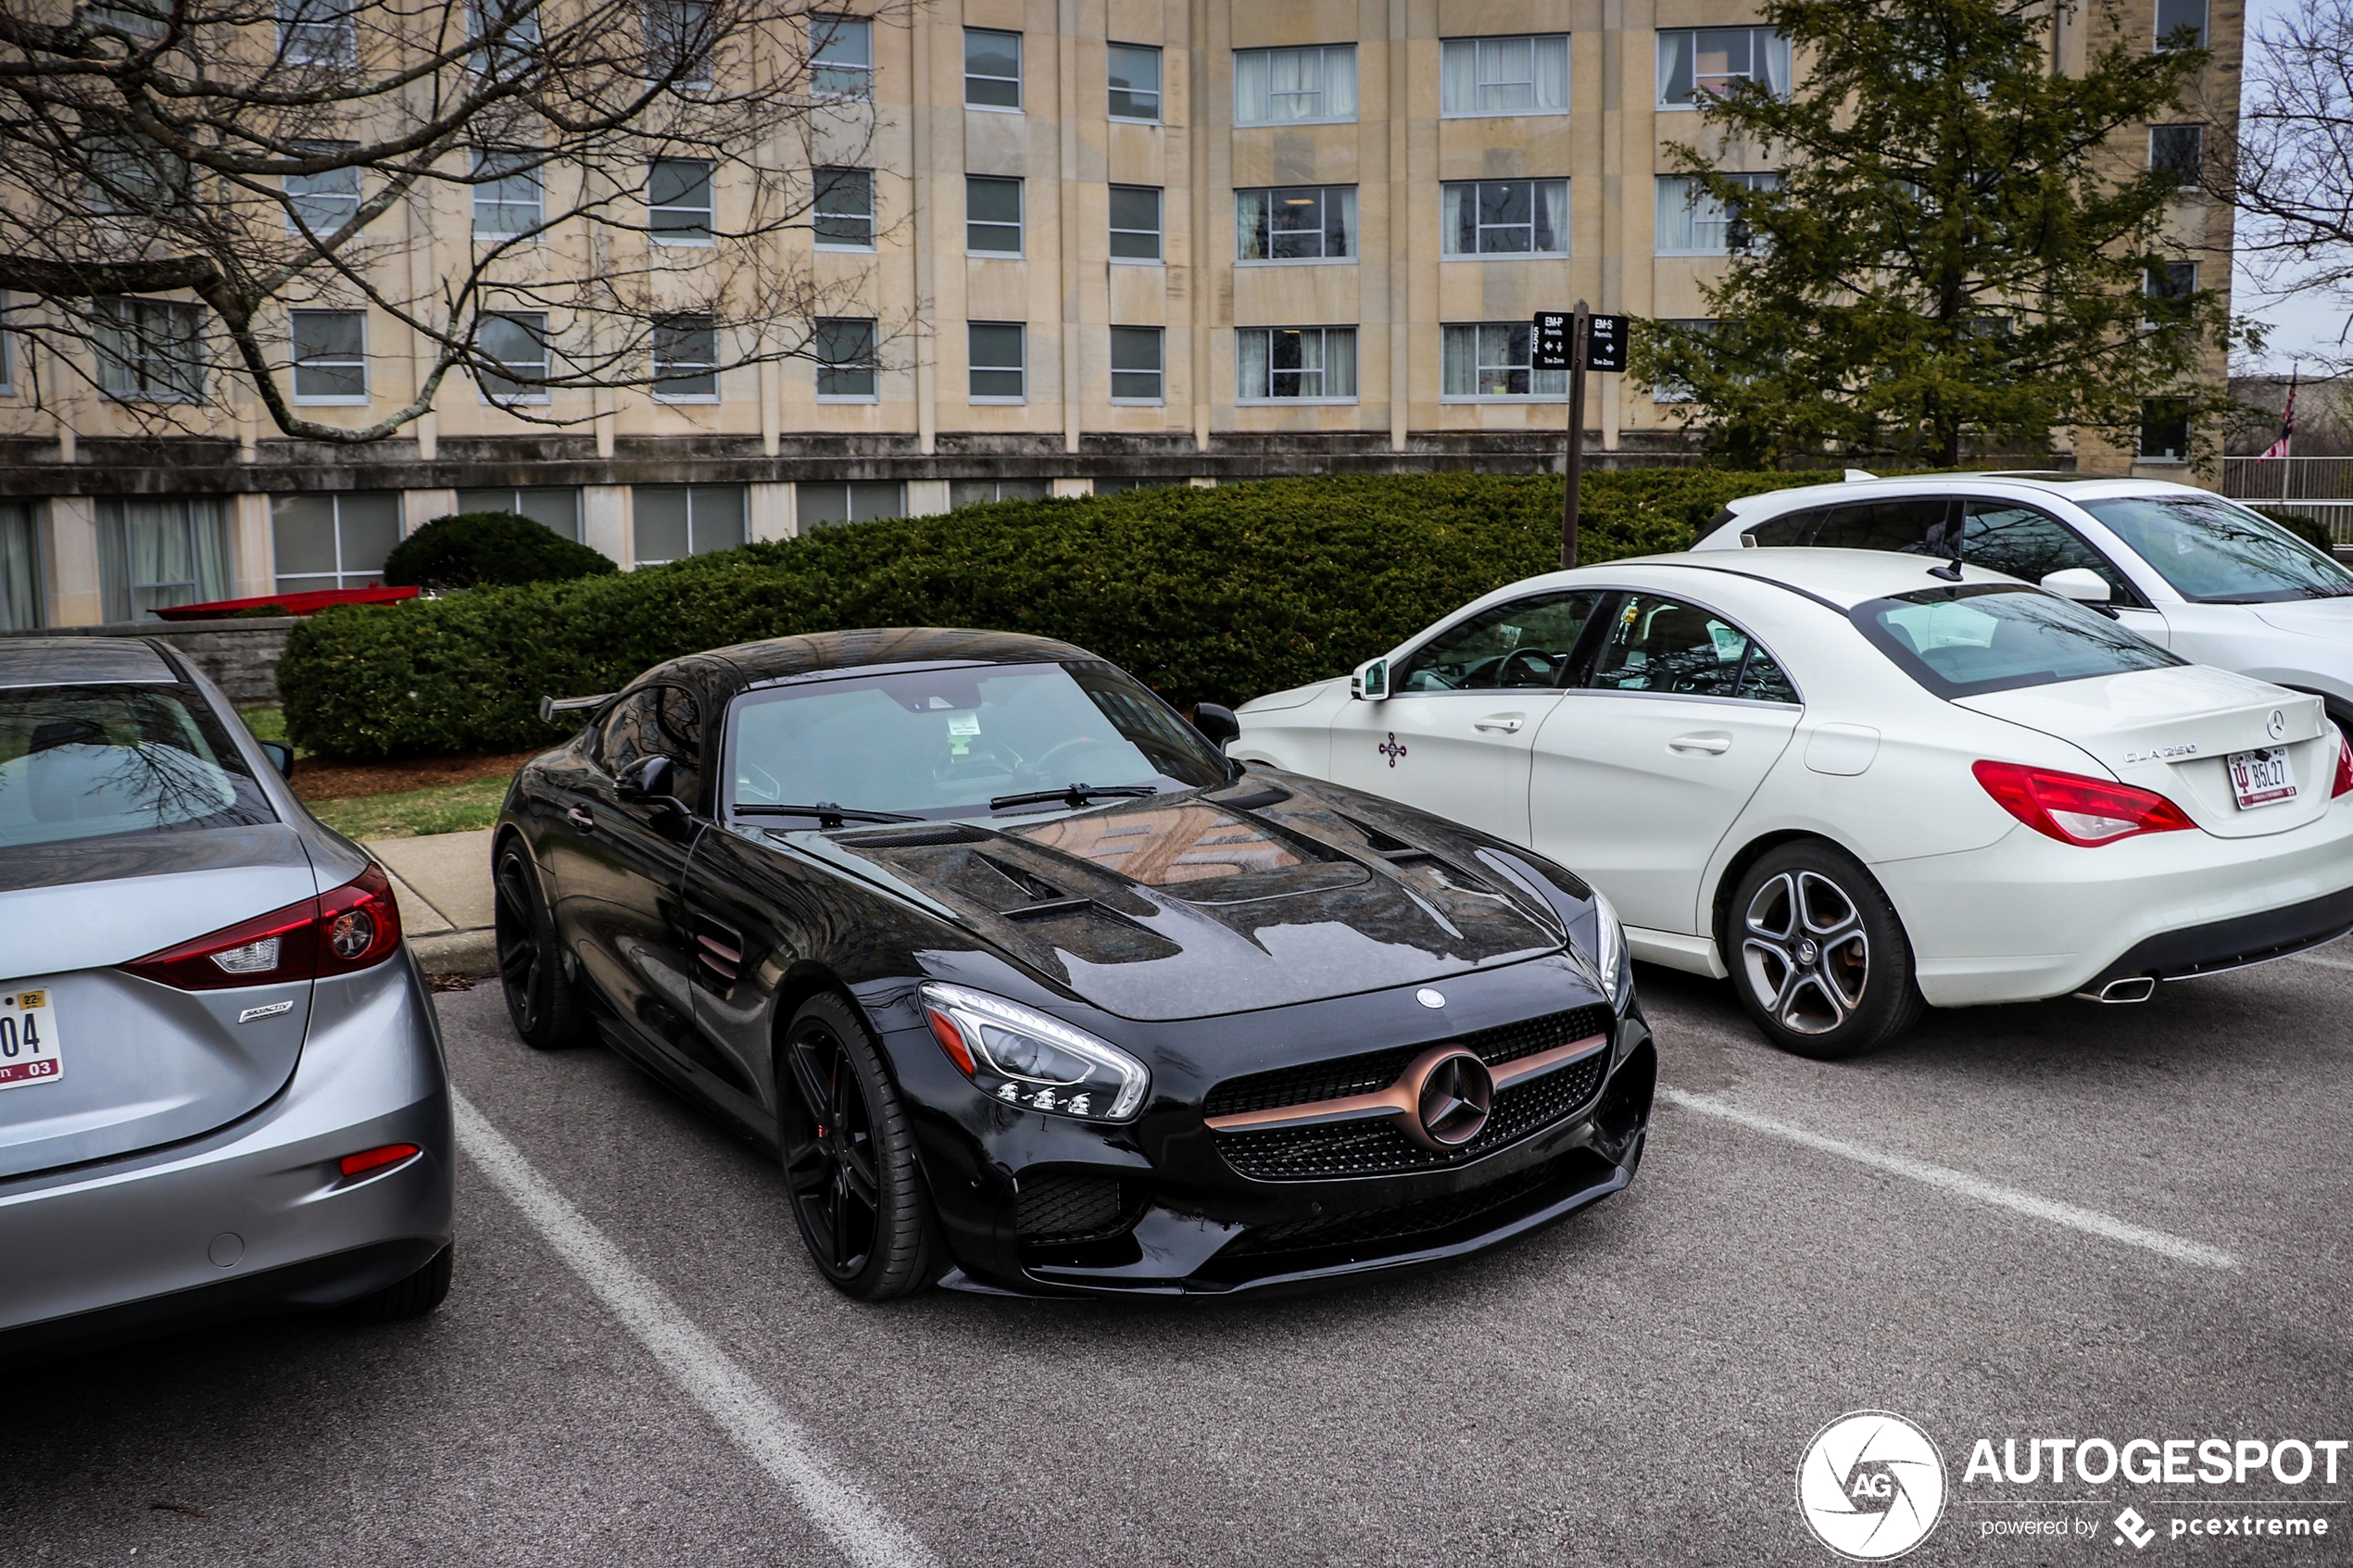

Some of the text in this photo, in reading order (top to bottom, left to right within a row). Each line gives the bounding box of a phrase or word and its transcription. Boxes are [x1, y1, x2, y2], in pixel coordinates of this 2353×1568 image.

[2123, 743, 2197, 763] CLA 250
[2252, 760, 2284, 788] B5L27
[24, 994, 38, 1006] 22
[29, 1061, 51, 1076] 03
